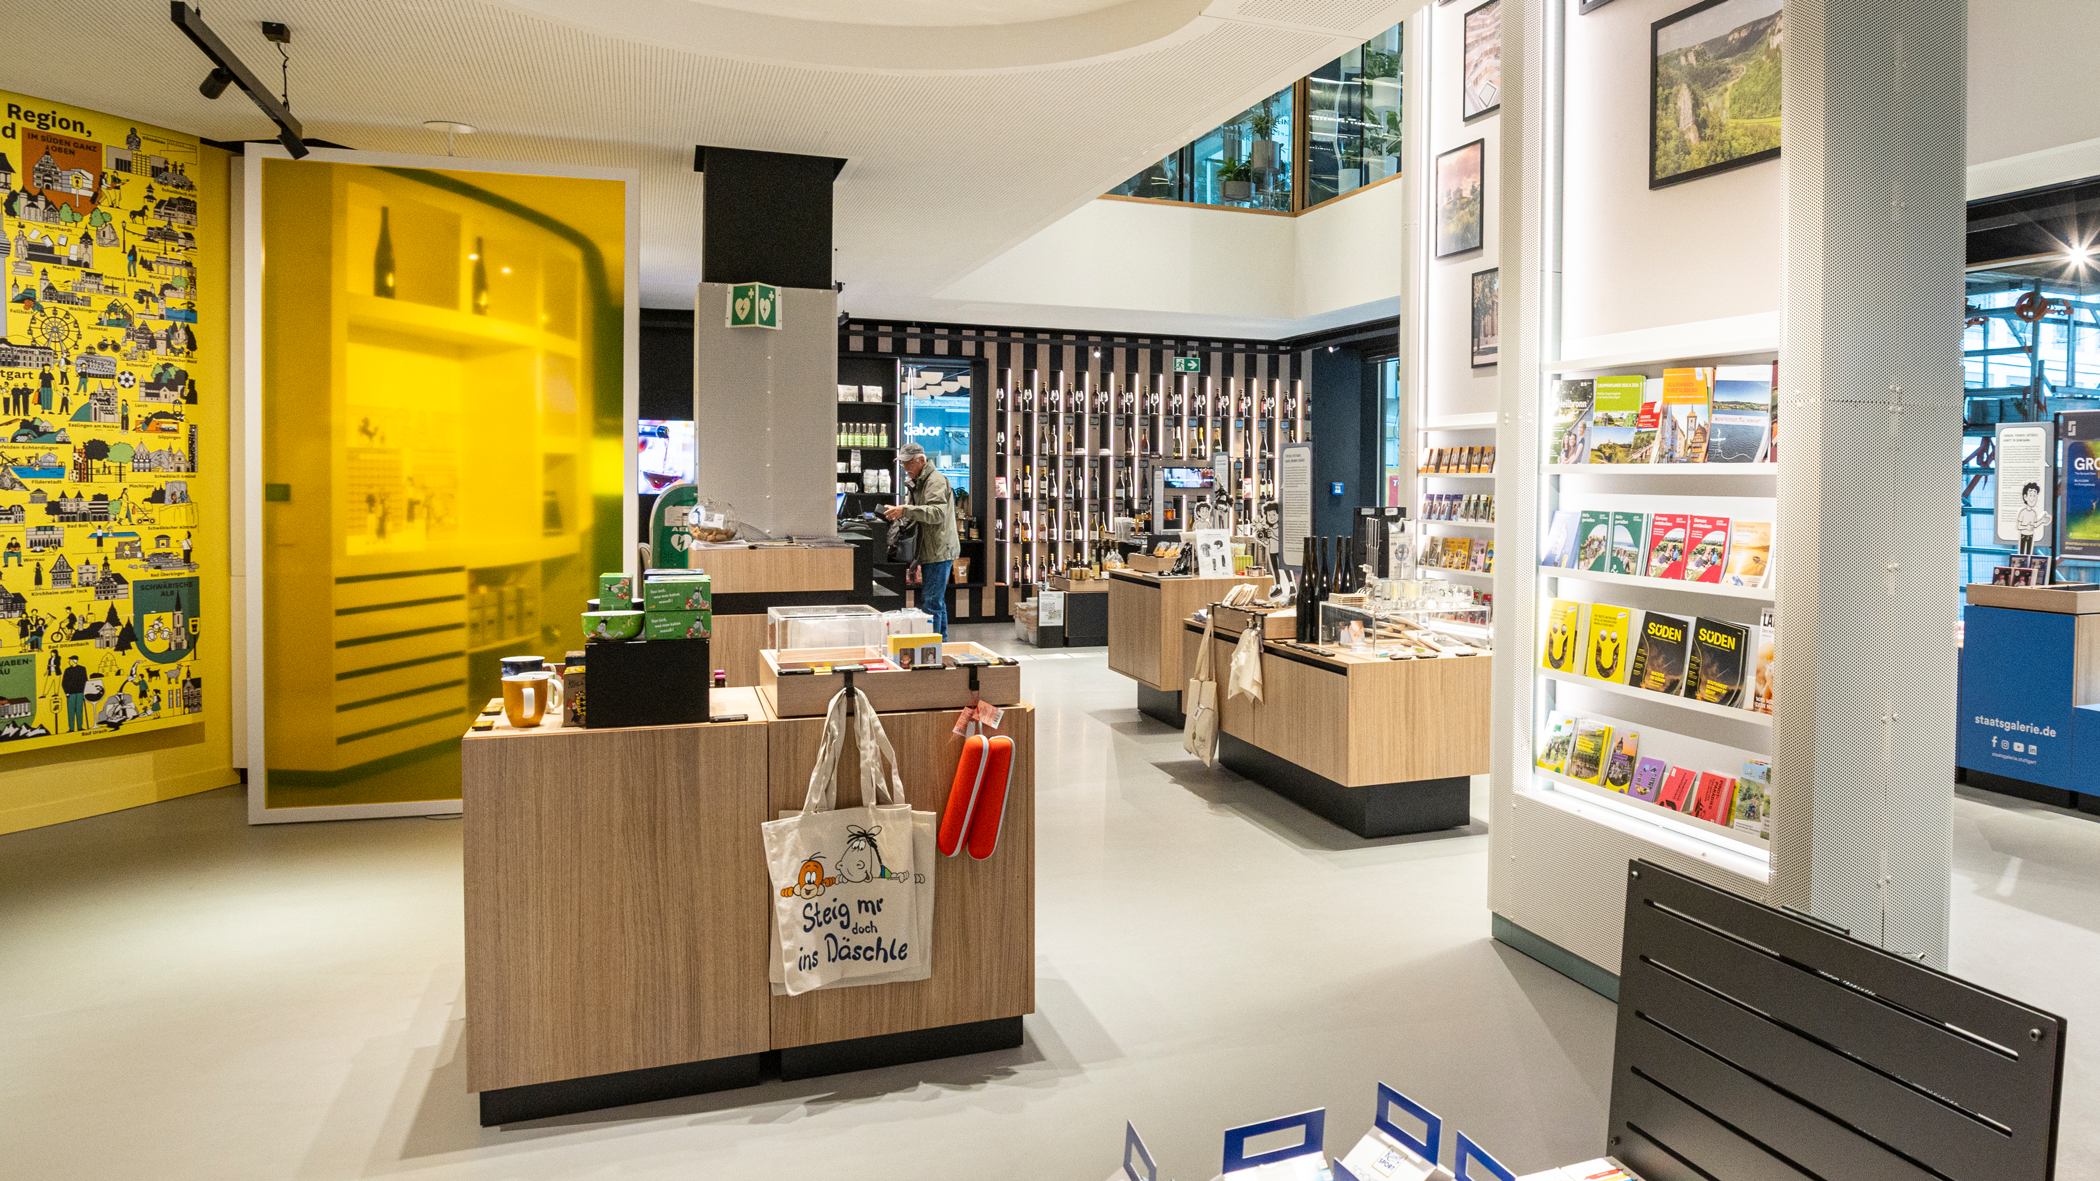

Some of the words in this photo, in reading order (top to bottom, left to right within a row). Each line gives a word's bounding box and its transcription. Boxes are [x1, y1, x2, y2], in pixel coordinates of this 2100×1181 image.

[7, 103, 92, 137] Region,
[1, 122, 16, 139] d
[41, 135, 71, 147] SÜDEN
[73, 142, 97, 152] GANZ
[51, 146, 75, 155] OBEN
[140, 581, 193, 591] SCHWÄBISCHE
[1763, 613, 1774, 628] LA
[1647, 622, 1682, 642] SÜDEN
[1698, 628, 1736, 650] SÜDEN
[1974, 715, 2057, 738] staatsgalerie.de
[802, 898, 850, 932] Steig
[858, 898, 883, 915] mr
[852, 921, 878, 935] doch
[798, 947, 819, 972] ins
[824, 933, 908, 963] Däschle
[1378, 1158, 1395, 1171] SPORT
